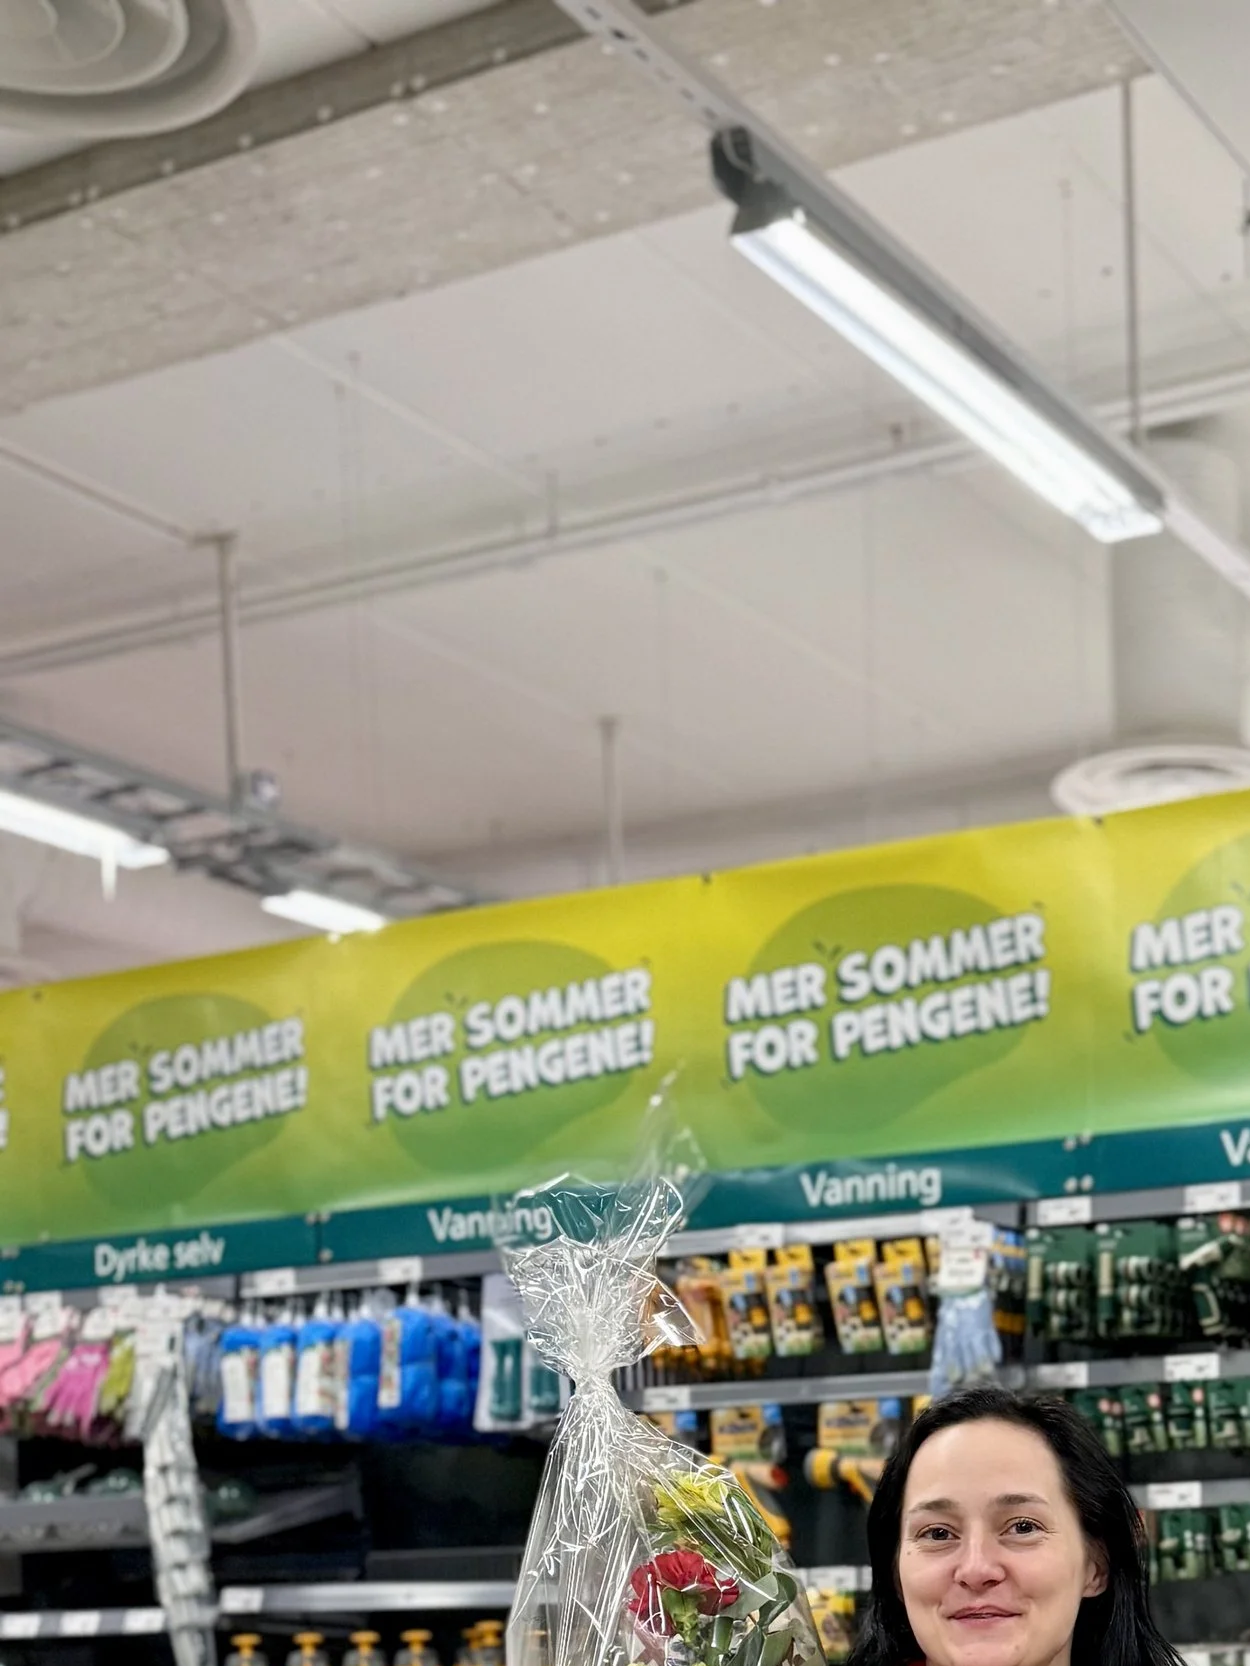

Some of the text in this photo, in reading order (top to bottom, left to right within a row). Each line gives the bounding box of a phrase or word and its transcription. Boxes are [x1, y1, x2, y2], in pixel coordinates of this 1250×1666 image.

[725, 913, 1046, 1024] MER SOMMER
[1130, 905, 1246, 973] MER
[369, 966, 652, 1069] MER SOMMER
[727, 968, 1051, 1080] FOR PENGENE!
[1131, 968, 1234, 1033] FOR
[64, 1065, 140, 1113] MER
[148, 1017, 304, 1090] SOMMER
[371, 1020, 655, 1122] FOR PENGENE!
[64, 1110, 134, 1162] FOR
[143, 1066, 308, 1146] PENGENE!
[427, 1203, 553, 1243] Vanning
[800, 1167, 942, 1210] Vanning
[94, 1232, 225, 1281] Dyrke selv
